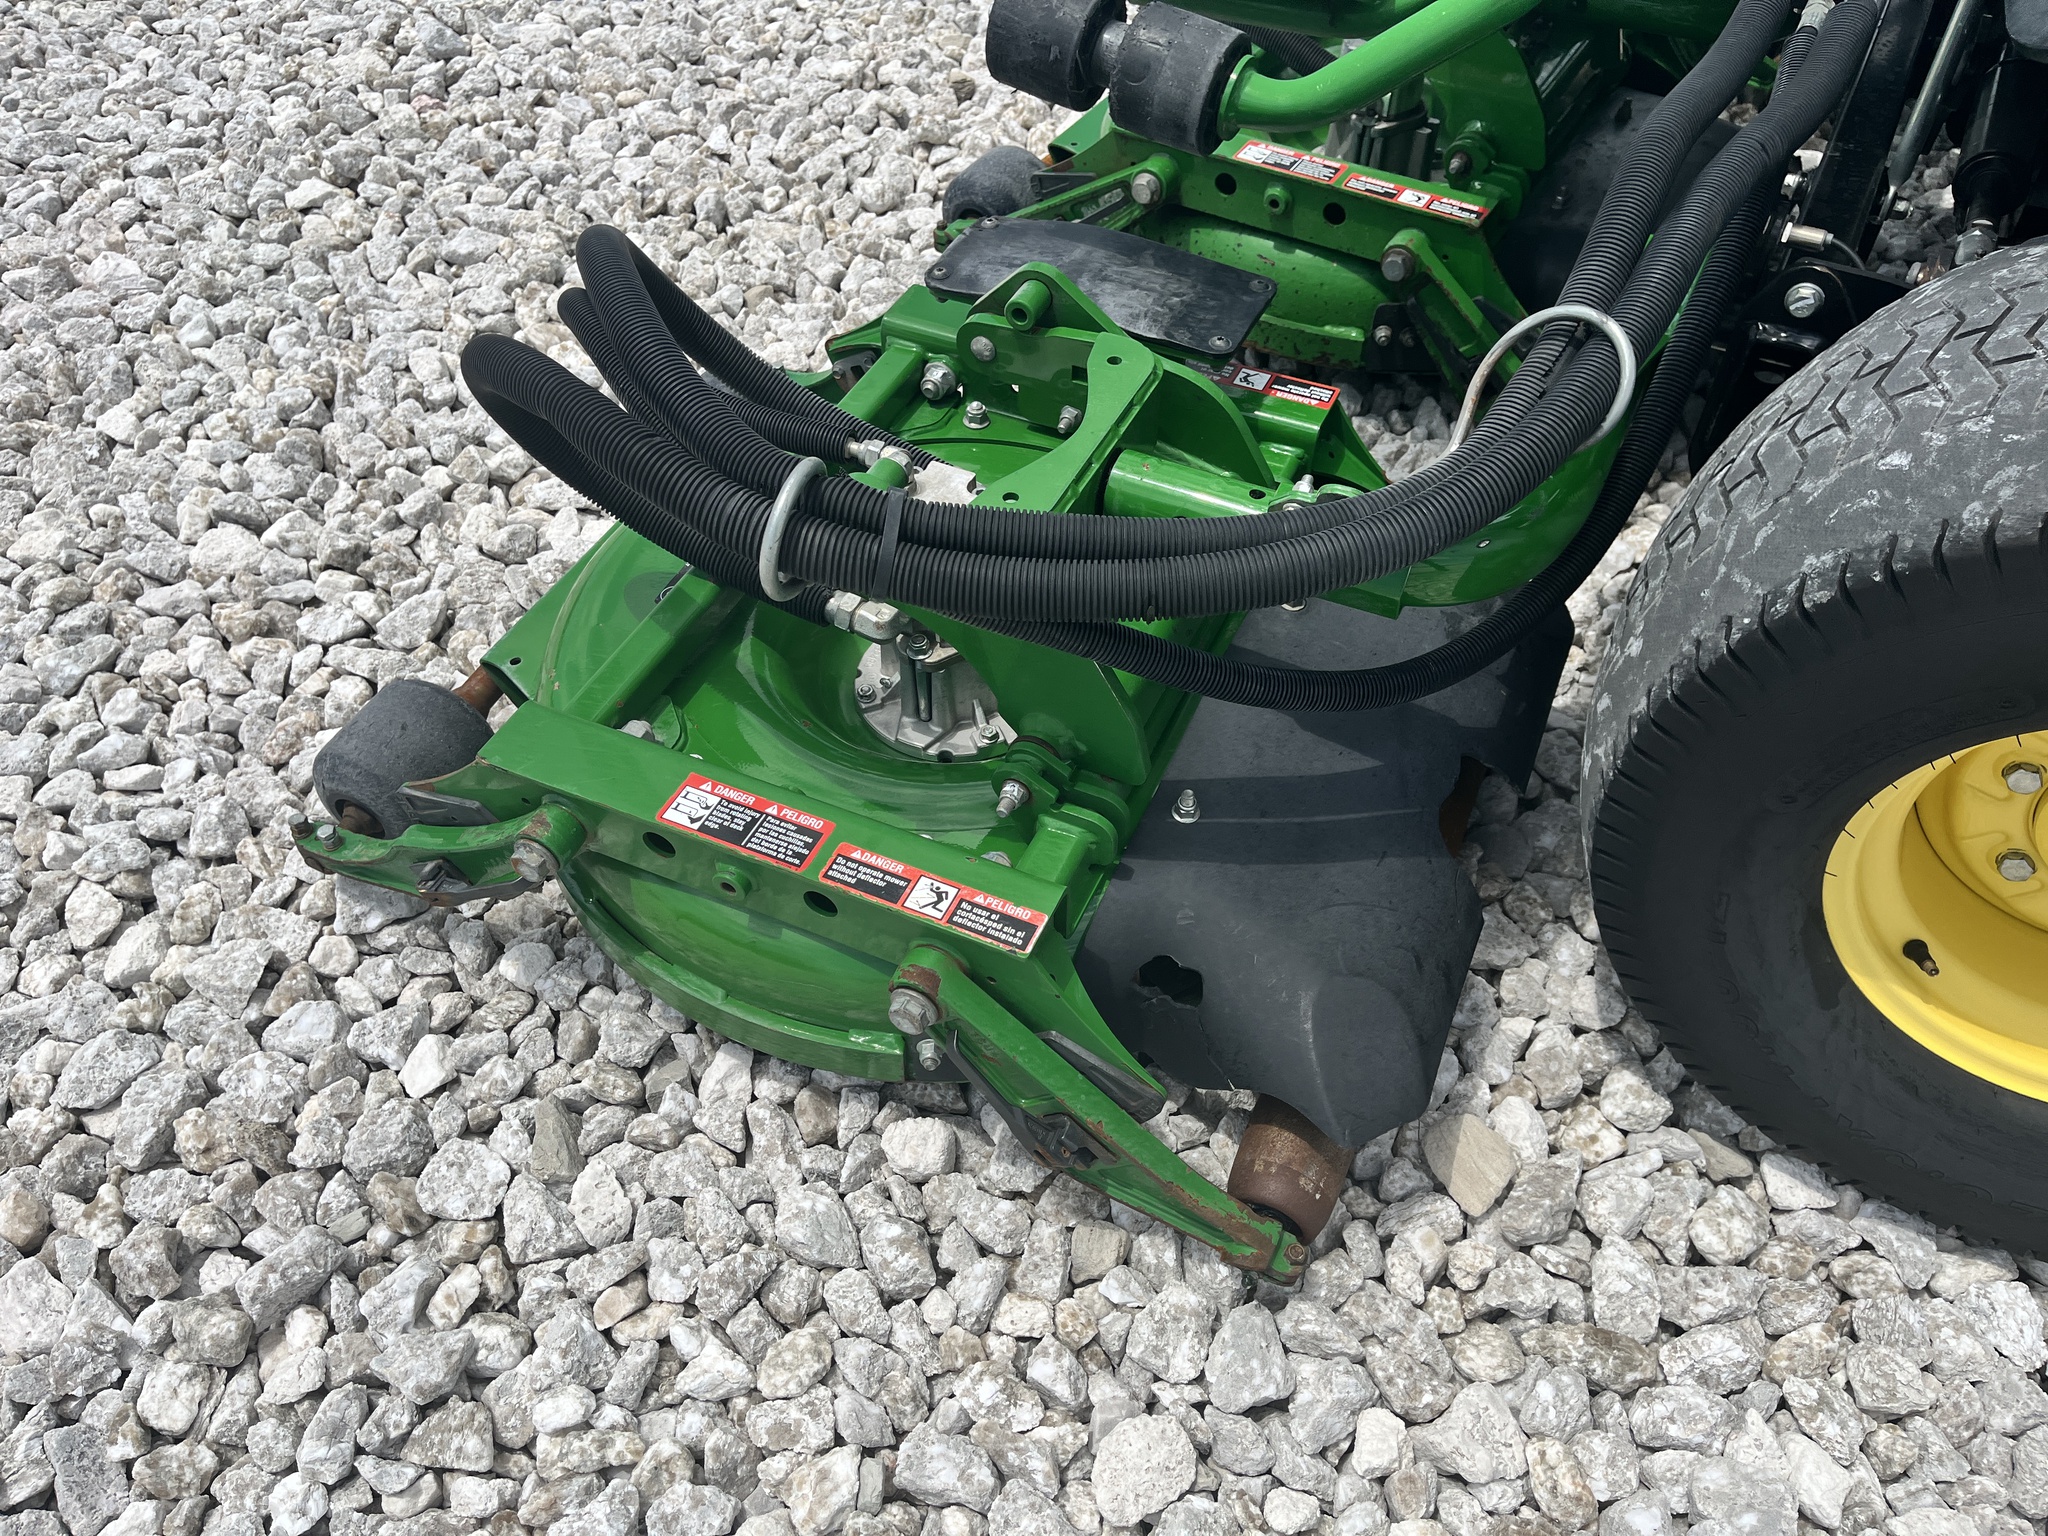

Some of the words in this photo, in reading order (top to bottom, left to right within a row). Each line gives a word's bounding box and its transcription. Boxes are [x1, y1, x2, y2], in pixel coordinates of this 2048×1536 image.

[1275, 391, 1311, 405] DANGER
[713, 785, 756, 805] DANGER
[716, 804, 730, 813] from
[730, 810, 752, 822] rotating
[728, 803, 745, 812] avoid
[743, 808, 761, 818] injury
[780, 808, 824, 829] PELIGRO
[704, 820, 719, 829] edge.
[708, 815, 723, 824] clear
[730, 823, 744, 831] deck
[733, 818, 746, 826] stay
[762, 821, 787, 834] lesiones
[786, 830, 814, 843] causadas
[766, 816, 780, 825] Para
[780, 821, 798, 831] evitar
[754, 832, 788, 847] mantenerse
[787, 843, 810, 855] alejado
[757, 826, 769, 834] por
[768, 829, 779, 838] las
[778, 833, 805, 848] cuchillas,
[760, 839, 778, 851] borde
[746, 842, 777, 857] plataforma
[776, 852, 786, 860] de
[785, 856, 801, 866] corte.
[861, 852, 905, 874] DANGER
[827, 870, 857, 884] attached
[831, 863, 858, 877] without
[856, 872, 887, 887] deflector
[836, 856, 846, 865] Do
[846, 861, 859, 870] not
[858, 864, 884, 879] operate
[884, 874, 908, 887] mower
[960, 901, 972, 911] No
[972, 906, 991, 917] usar
[990, 913, 1000, 921] el
[985, 896, 1032, 920] PELIGRO
[952, 915, 987, 932] deflector
[987, 927, 1023, 946] instalado
[956, 909, 1003, 930] cortacésped
[1002, 926, 1016, 935] sin
[1016, 931, 1026, 939] el
